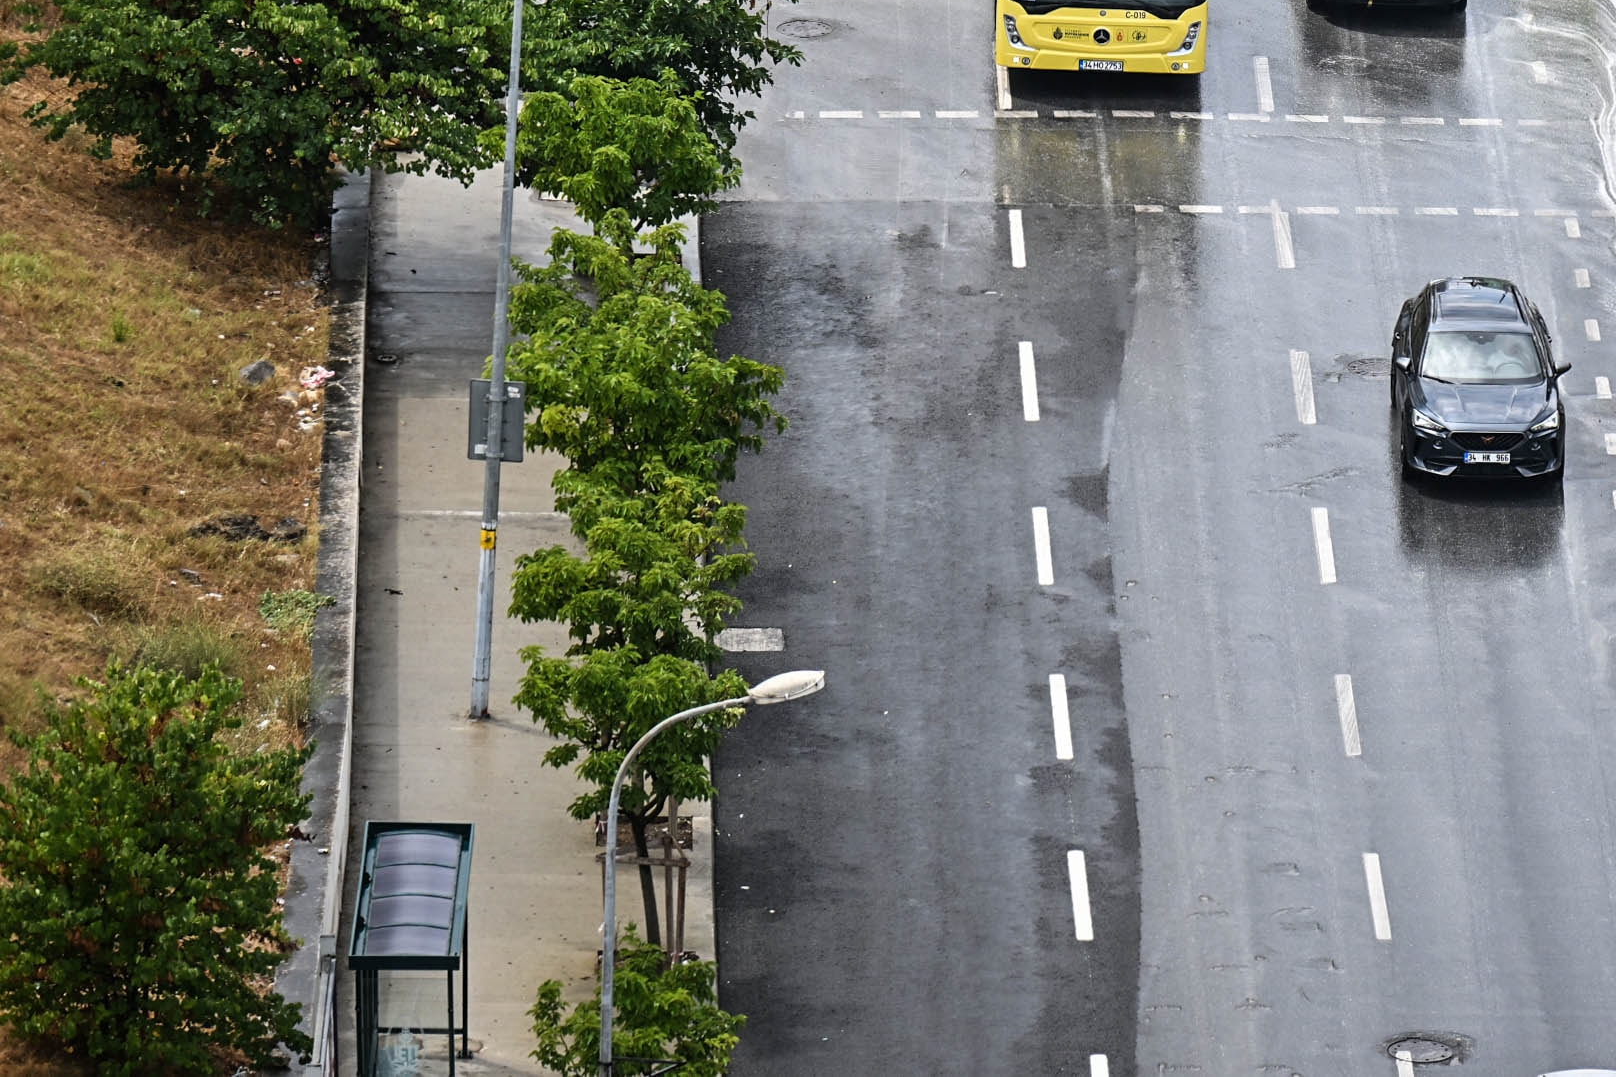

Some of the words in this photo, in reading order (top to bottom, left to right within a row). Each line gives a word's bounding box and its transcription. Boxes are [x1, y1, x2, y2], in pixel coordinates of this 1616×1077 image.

[1125, 11, 1146, 19] C-019
[1084, 61, 1091, 69] 34
[1105, 62, 1121, 70] 2753
[1496, 454, 1509, 462] 966
